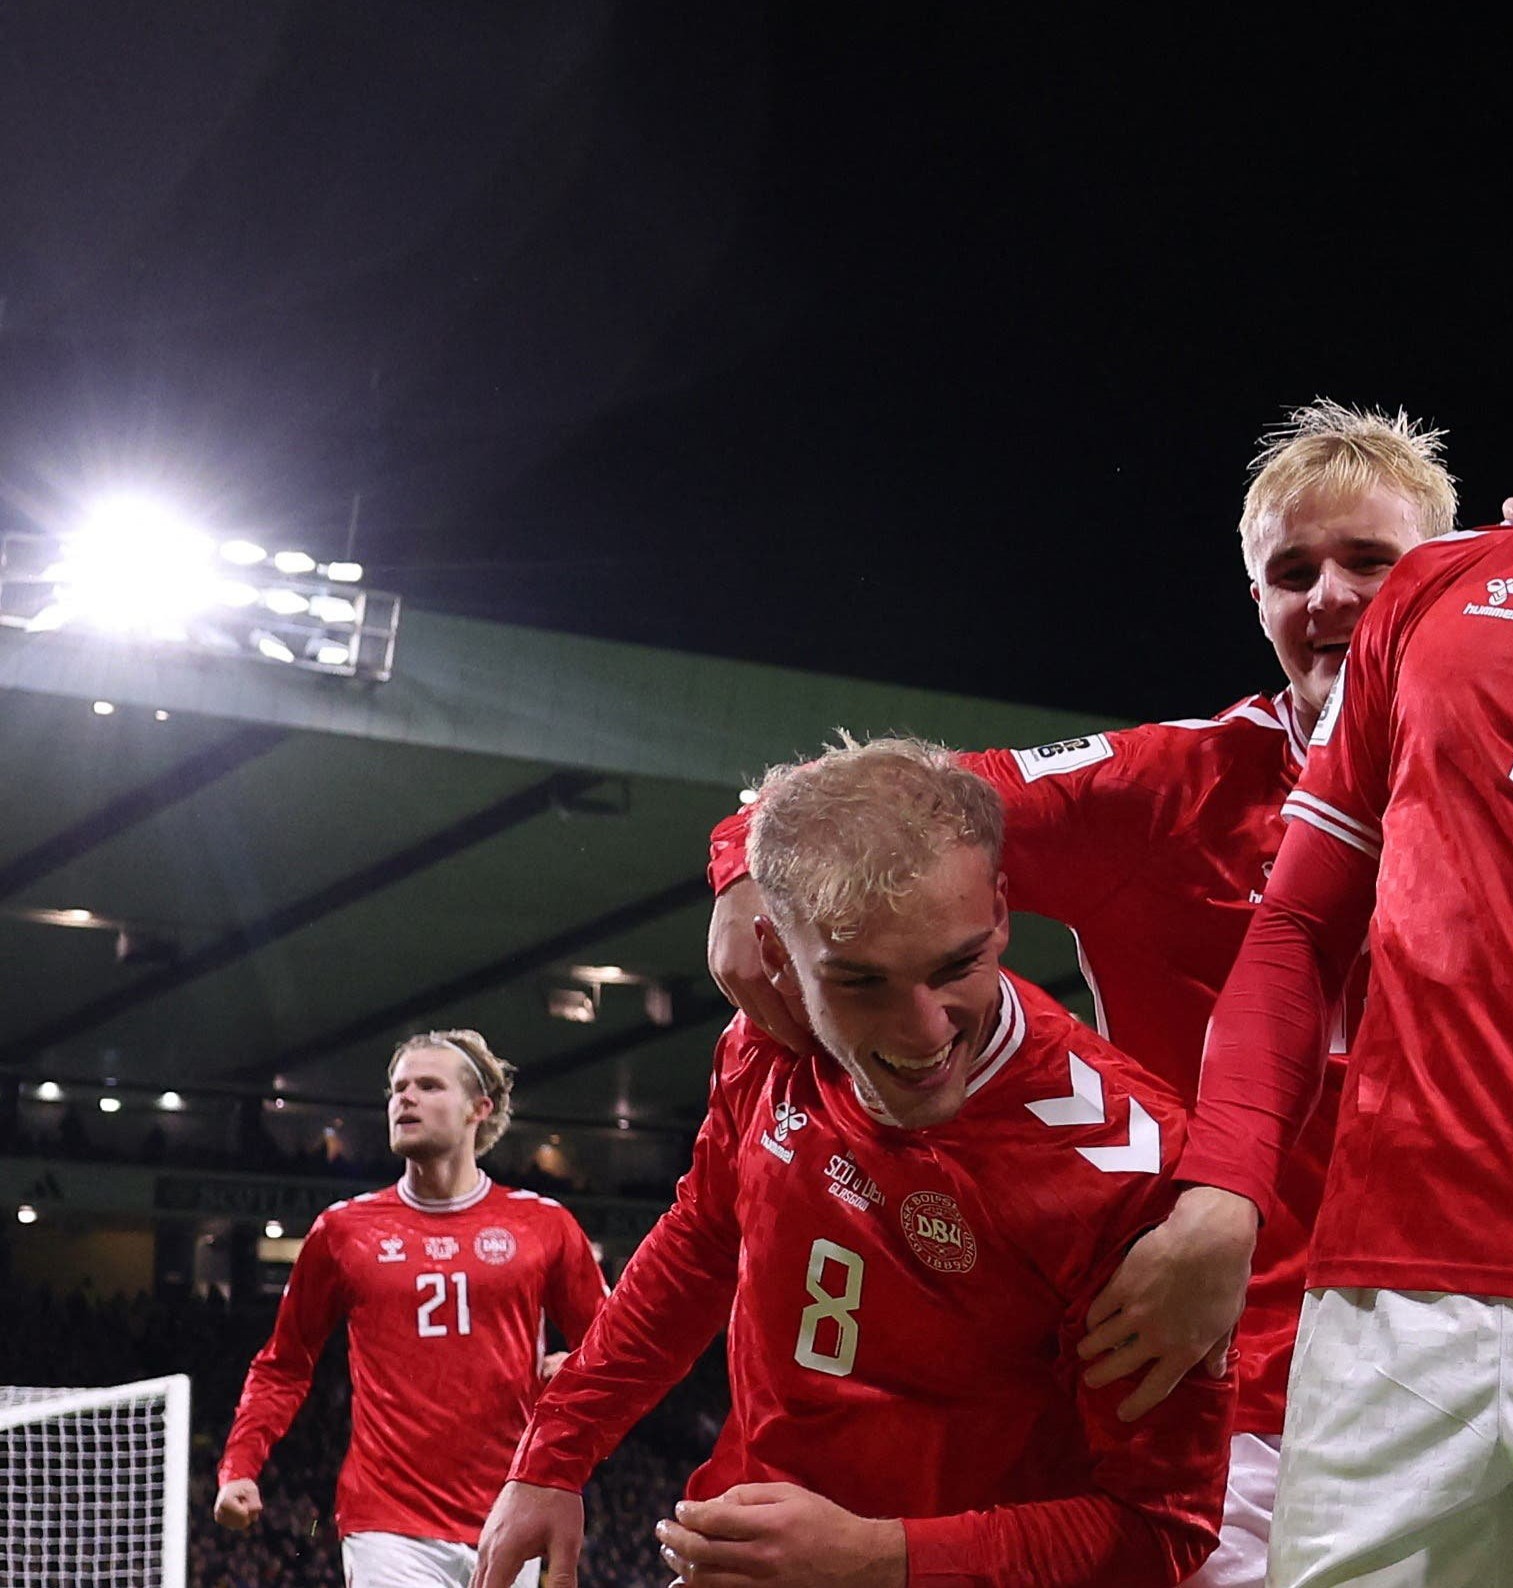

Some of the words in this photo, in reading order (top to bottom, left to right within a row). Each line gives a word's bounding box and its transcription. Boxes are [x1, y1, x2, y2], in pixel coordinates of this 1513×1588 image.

[824, 1154, 857, 1185] SCO
[828, 1182, 870, 1212] GLASGOW
[917, 1214, 962, 1248] DBU
[416, 1271, 470, 1337] 21
[794, 1238, 864, 1377] 8
